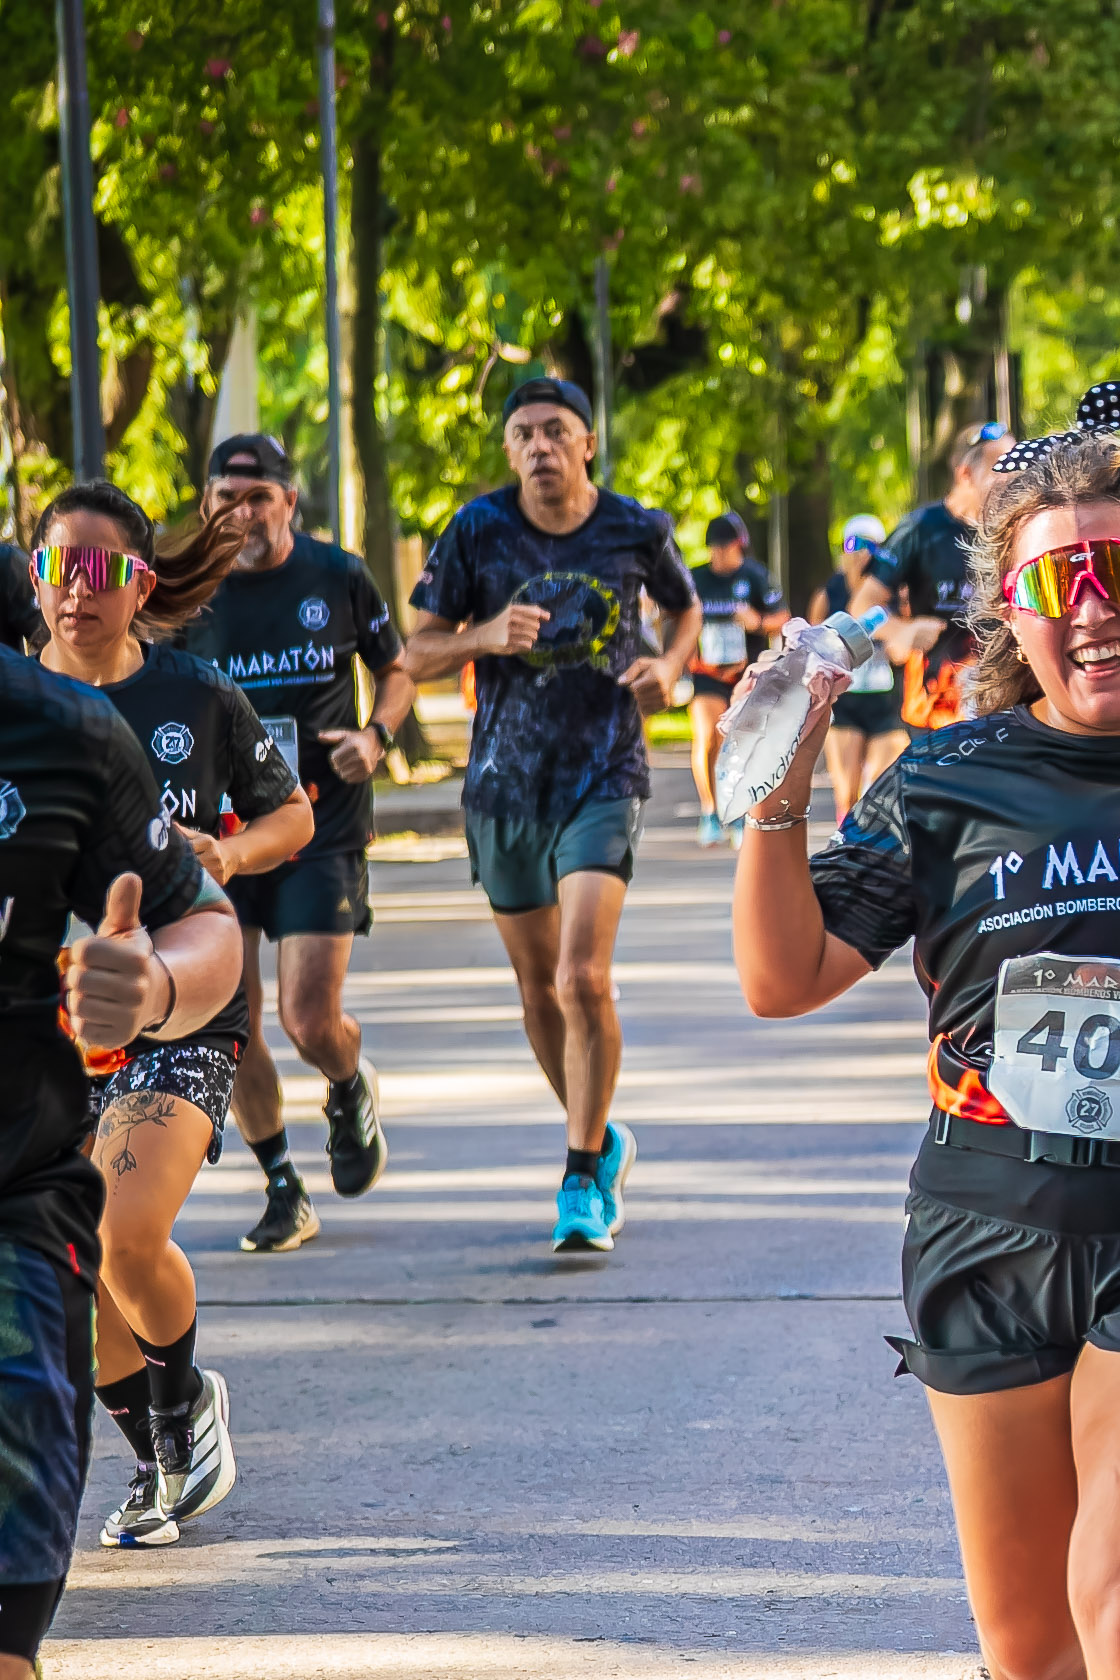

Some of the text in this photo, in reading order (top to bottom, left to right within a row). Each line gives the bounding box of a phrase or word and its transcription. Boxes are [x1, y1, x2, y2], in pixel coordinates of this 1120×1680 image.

[229, 640, 335, 678] MARATÓN
[978, 903, 1053, 934] ASOCIACIÓN
[1079, 1101, 1099, 1118] 27
